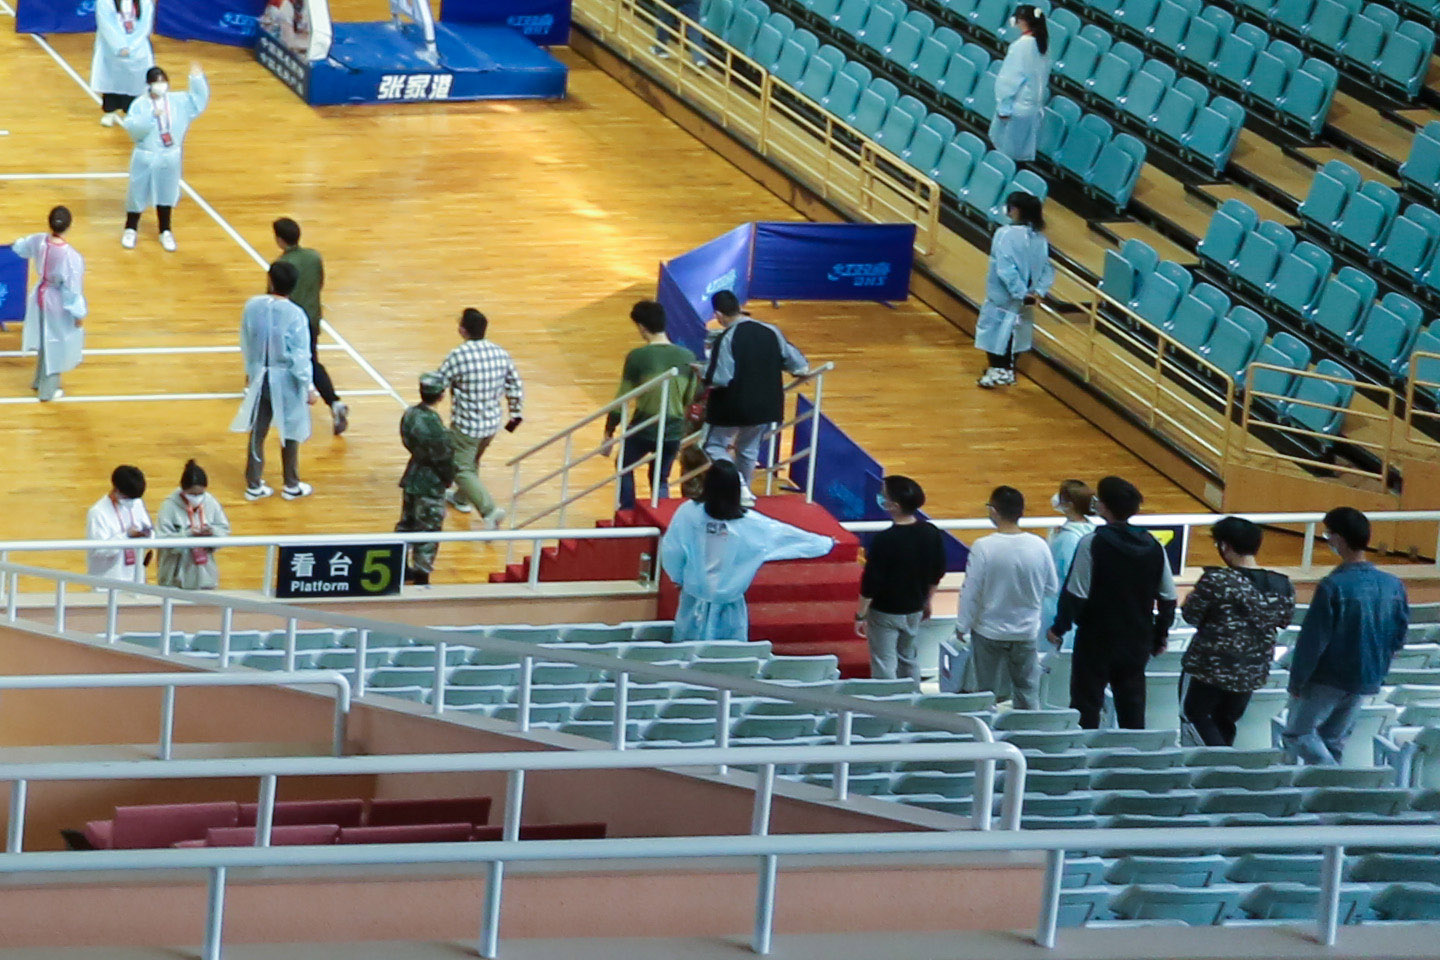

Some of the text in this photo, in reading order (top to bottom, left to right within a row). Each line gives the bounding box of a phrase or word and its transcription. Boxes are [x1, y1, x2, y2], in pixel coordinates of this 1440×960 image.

[377, 74, 453, 99] 张家港
[290, 549, 392, 592] 看台 5
[290, 580, 349, 592] Platform
